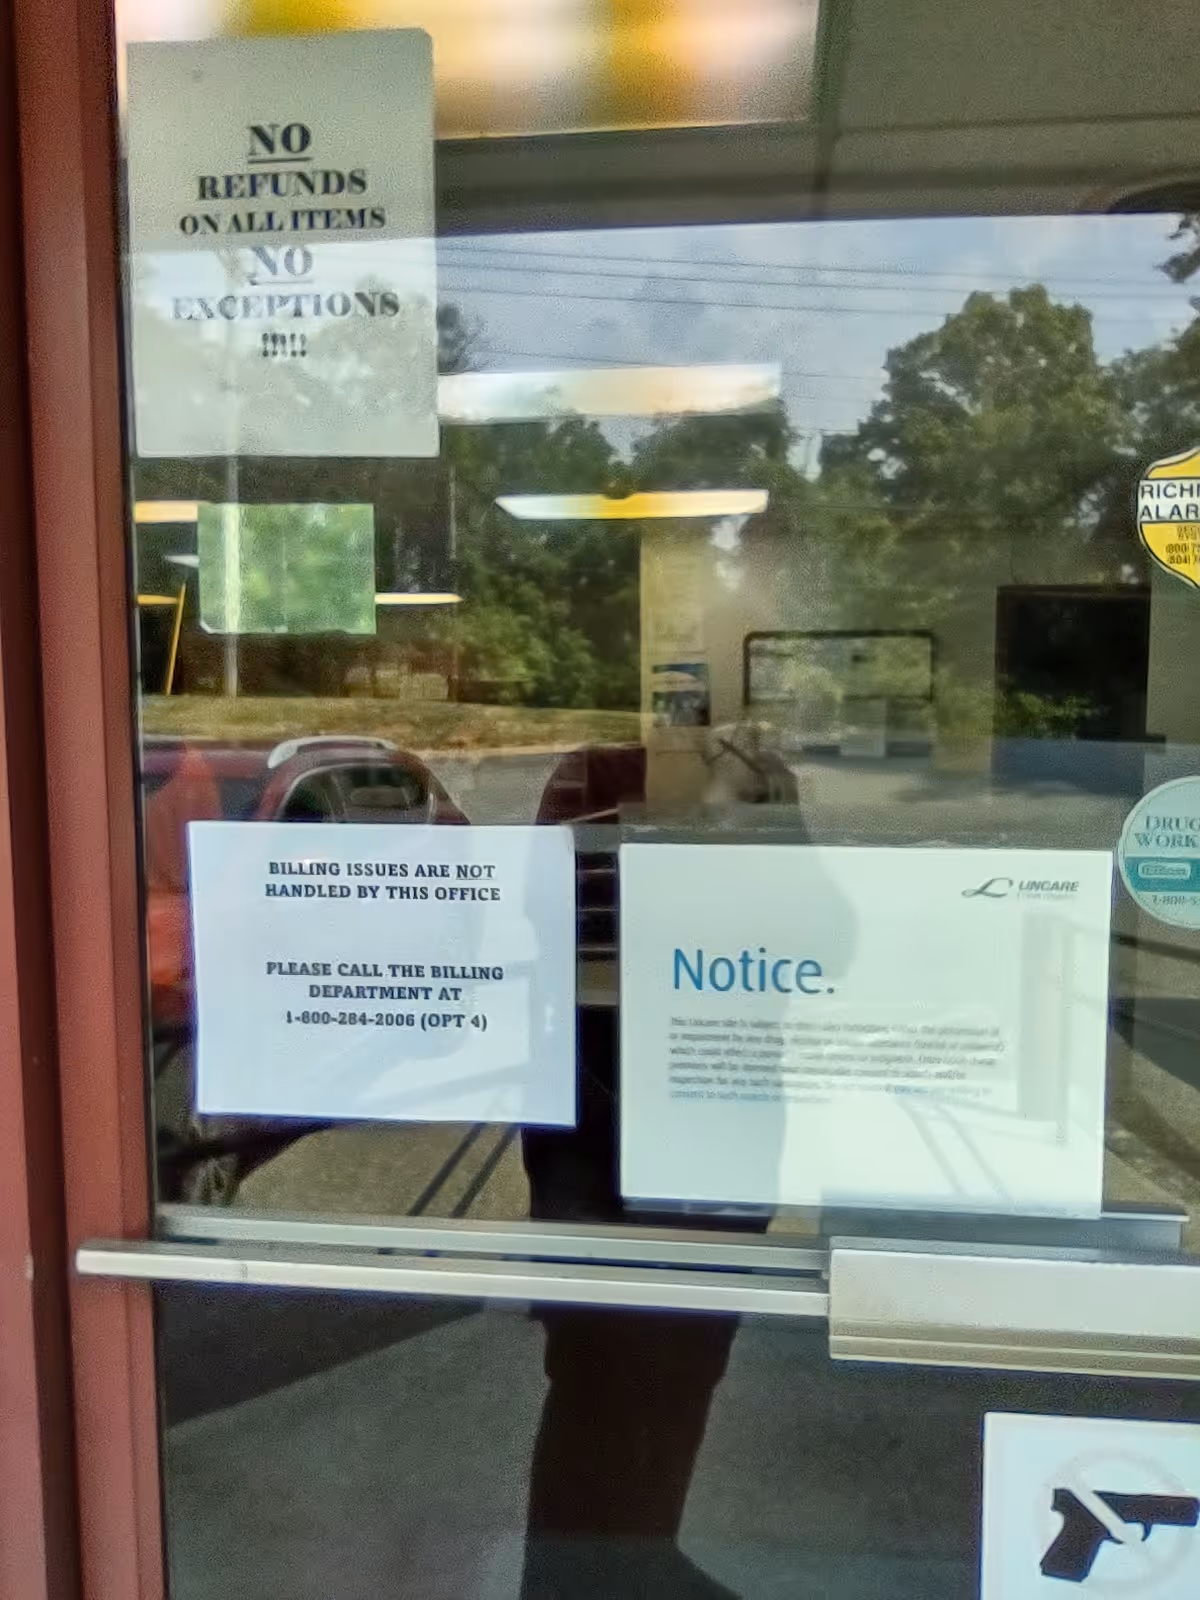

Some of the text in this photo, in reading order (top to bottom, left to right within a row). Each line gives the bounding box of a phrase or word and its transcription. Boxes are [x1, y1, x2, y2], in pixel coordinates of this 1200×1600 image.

[248, 122, 311, 156] NO
[197, 169, 367, 200] REFUNDS
[179, 207, 386, 235] ON ALL ITEMS
[249, 247, 313, 276] NO
[172, 292, 400, 320] EXCEPTIONS
[1141, 483, 1200, 499] RICH
[269, 862, 496, 880] BILLING ISSUES ARE NOT
[265, 884, 501, 901] HANDLED BY THIS OFFICE
[1019, 880, 1079, 892] LINCARE
[266, 962, 504, 980] PLEASE CALL THE BILLING
[673, 947, 836, 994] Notice.
[308, 985, 462, 1001] DEPARTMENT AT
[286, 1011, 488, 1031] 1-800-284-2006 (OPT 4)
